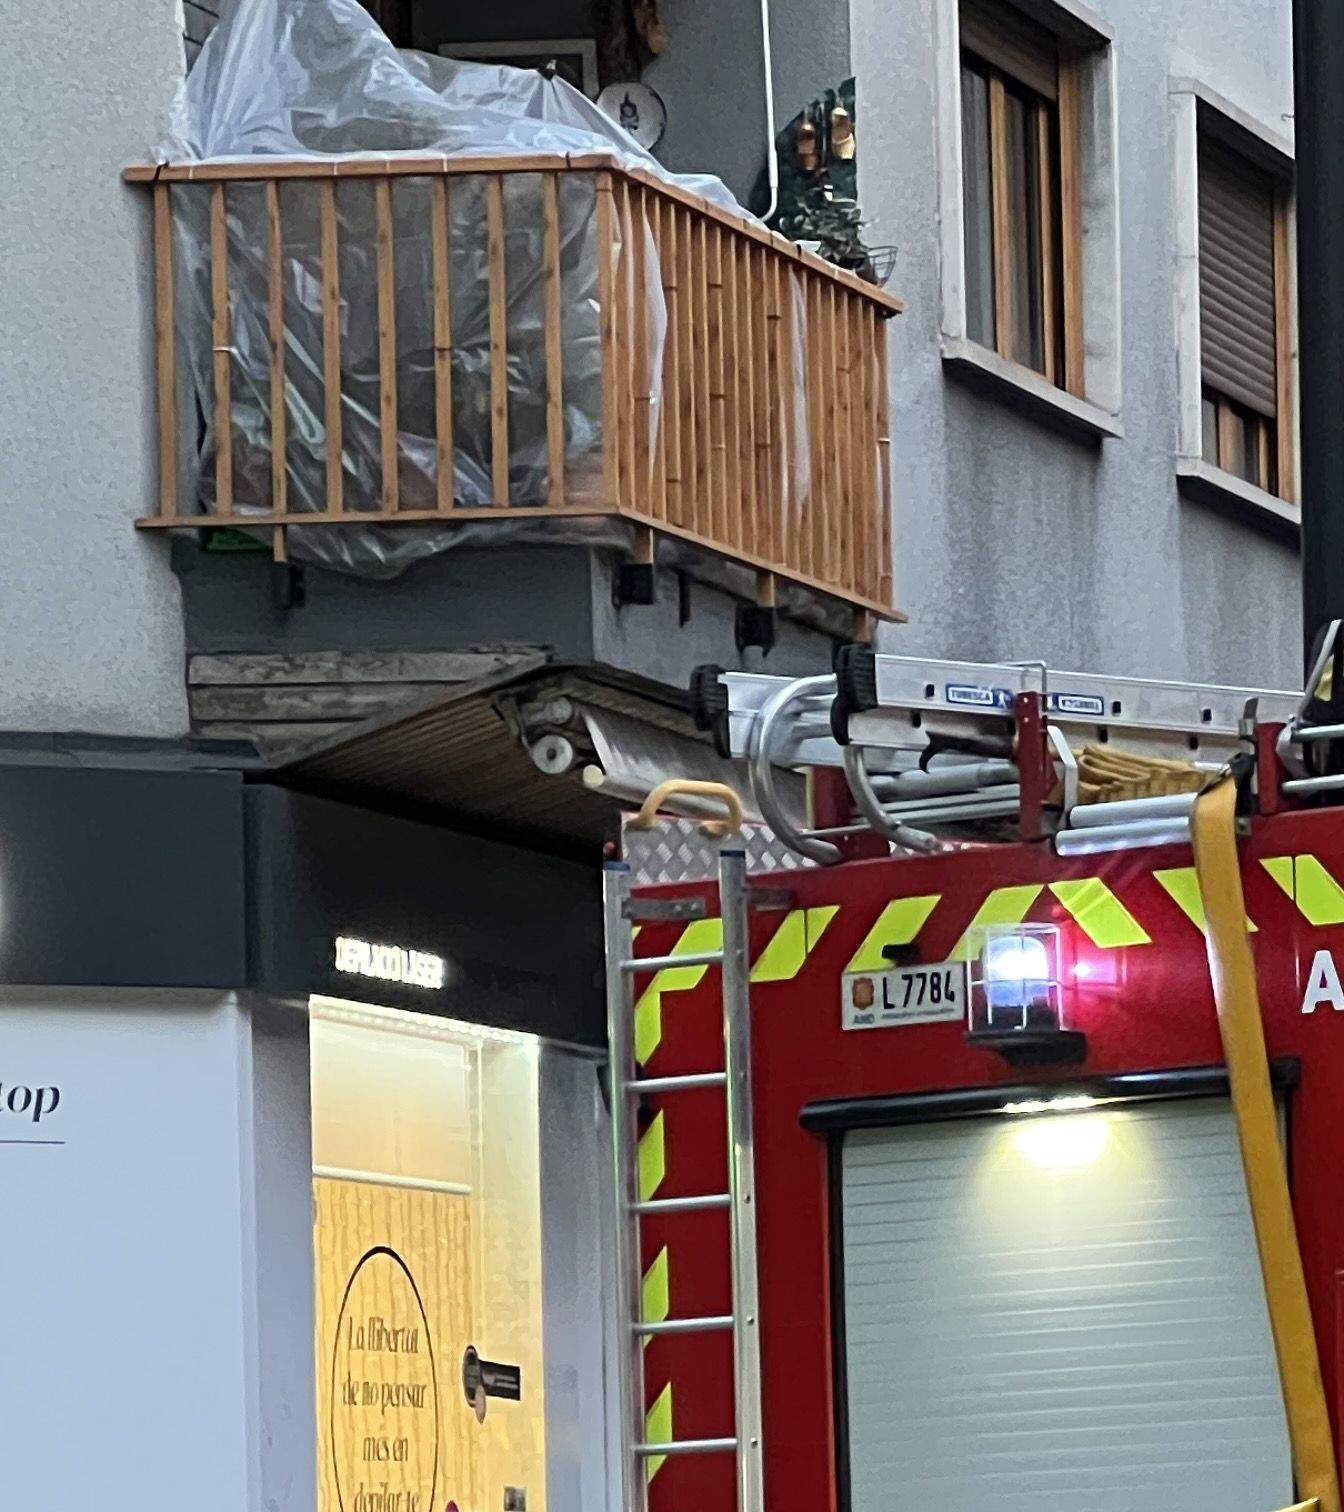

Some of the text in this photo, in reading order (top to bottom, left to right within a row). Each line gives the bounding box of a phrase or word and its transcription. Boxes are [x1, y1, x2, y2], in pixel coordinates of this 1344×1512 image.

[0, 1082, 61, 1123] op
[343, 1371, 359, 1406] de
[362, 1381, 379, 1406] no
